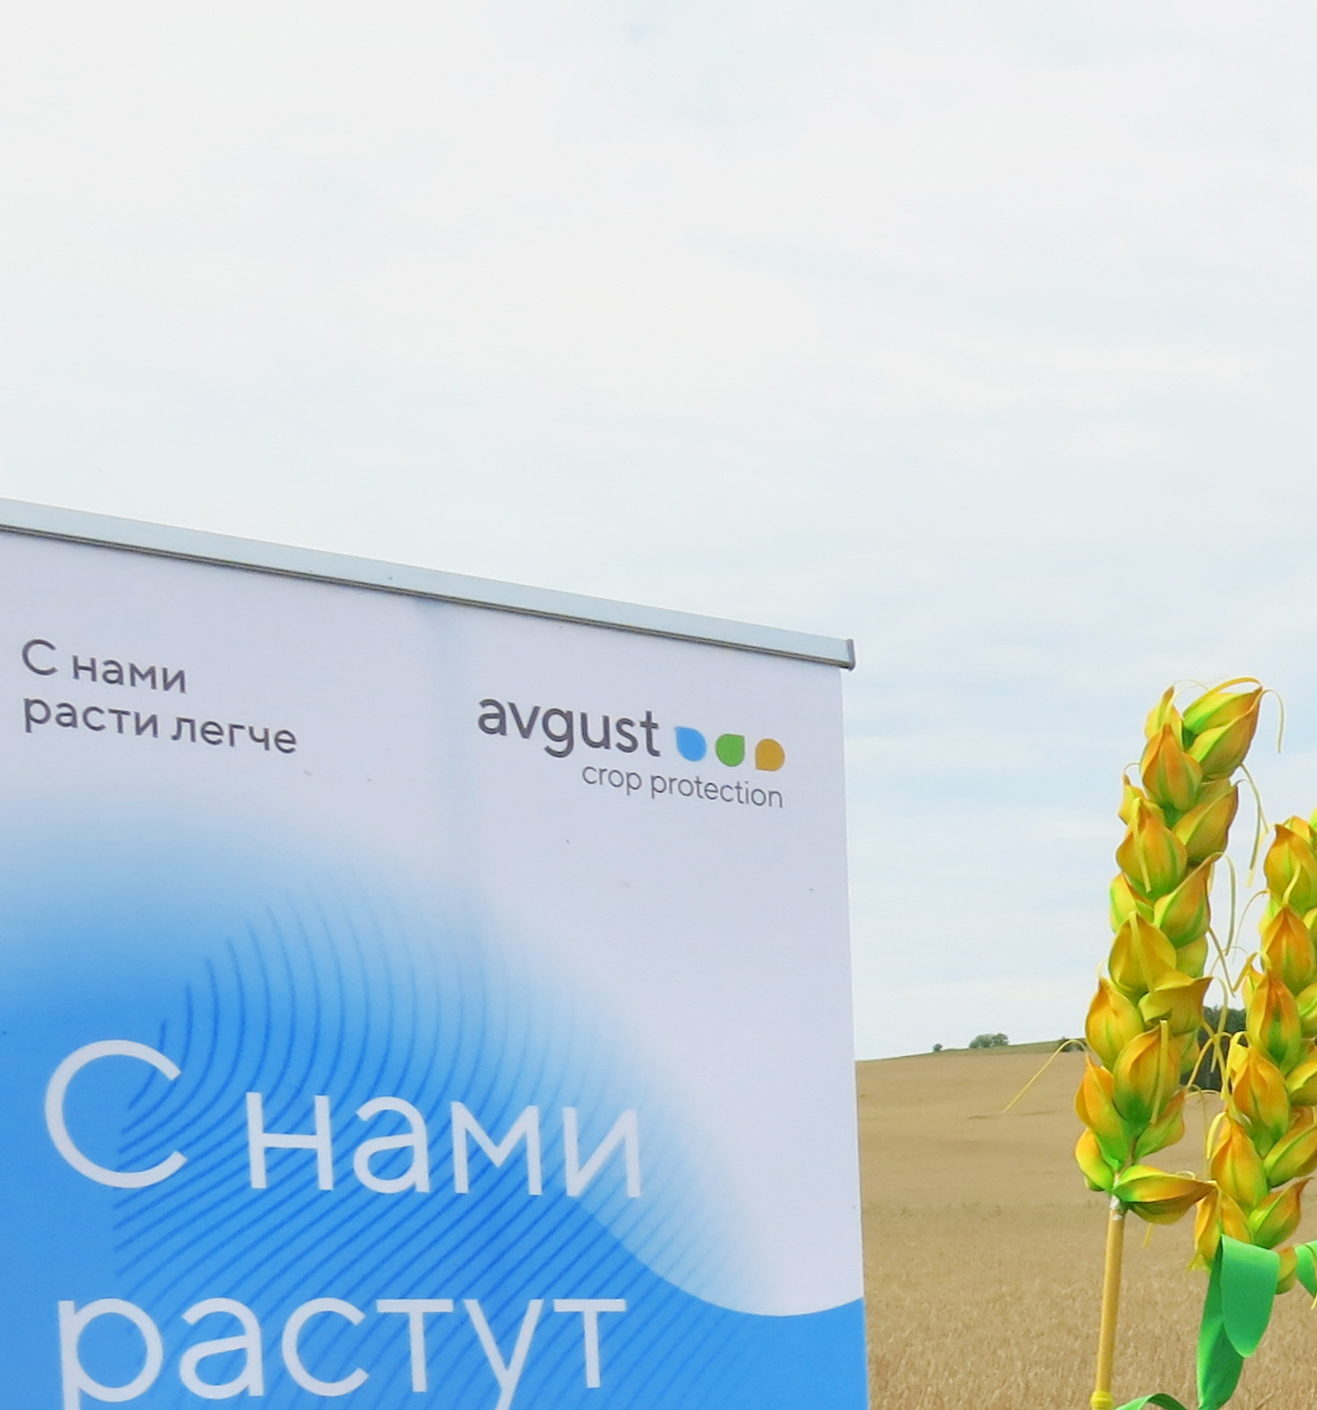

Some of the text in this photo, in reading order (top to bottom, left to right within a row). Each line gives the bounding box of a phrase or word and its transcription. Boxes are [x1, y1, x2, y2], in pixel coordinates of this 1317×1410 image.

[22, 638, 187, 694] С нами
[23, 697, 297, 754] расти легче
[477, 698, 660, 758] avgust
[582, 765, 784, 808] crop protection
[45, 1040, 643, 1198] С нами
